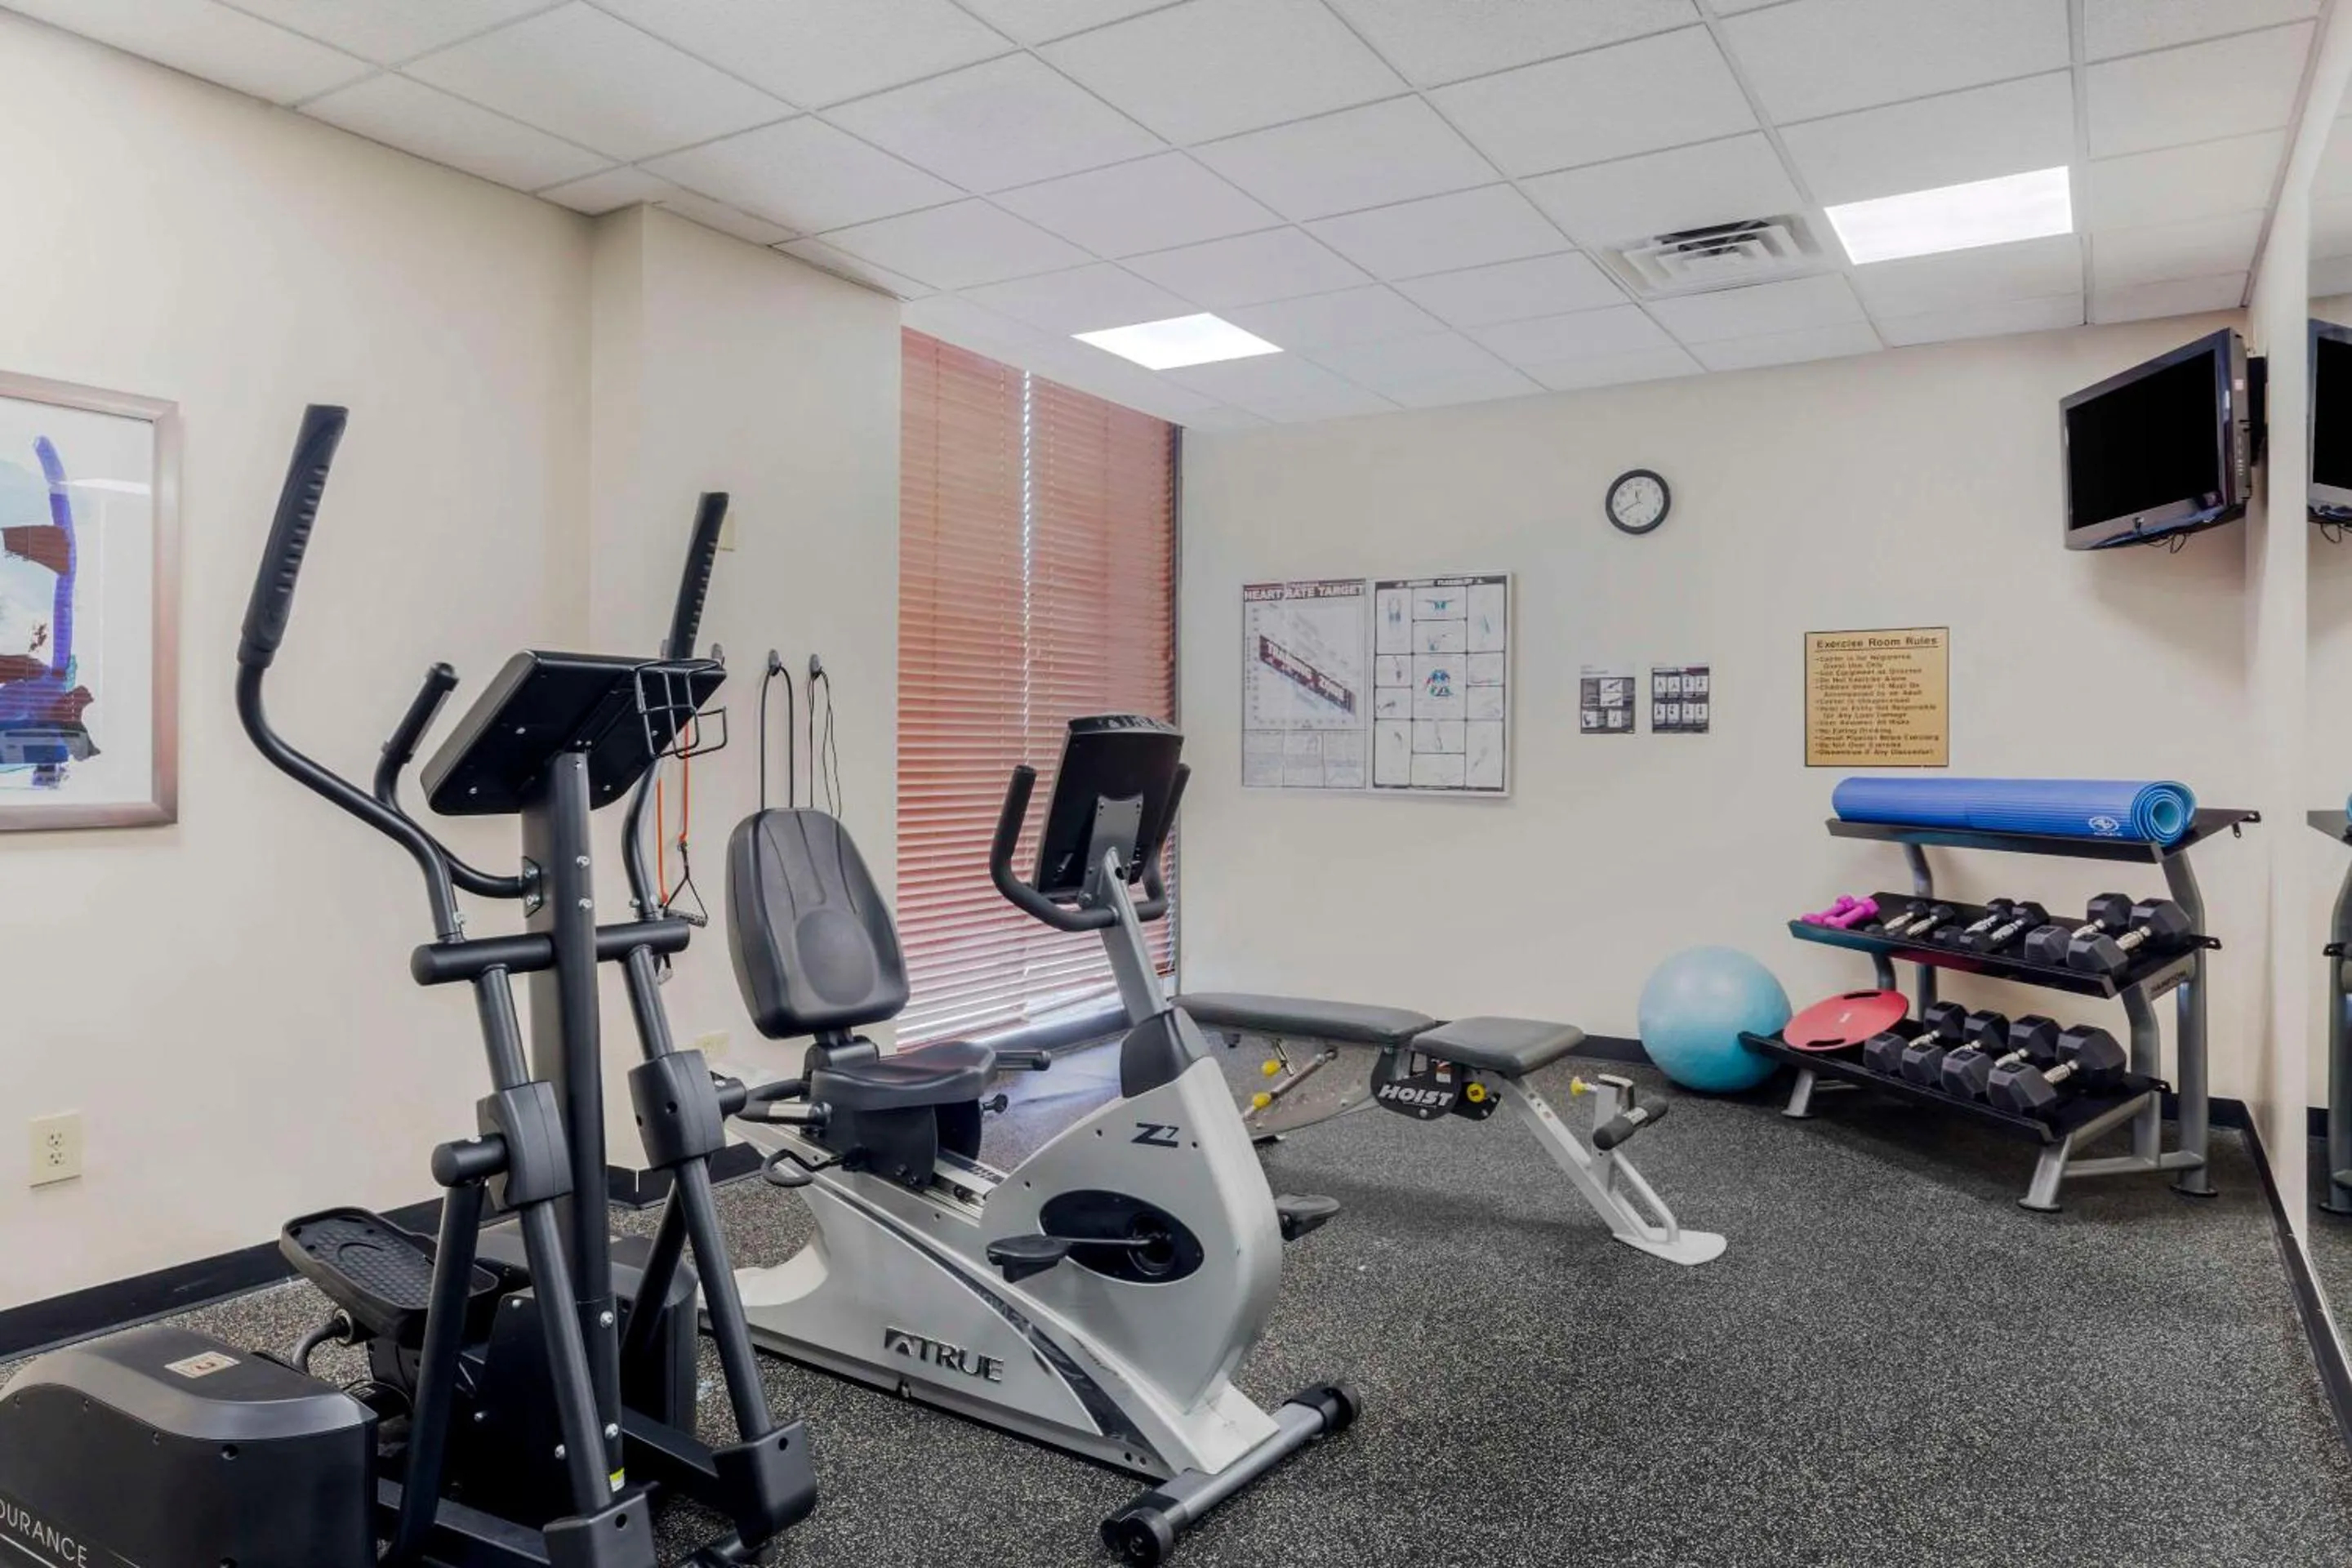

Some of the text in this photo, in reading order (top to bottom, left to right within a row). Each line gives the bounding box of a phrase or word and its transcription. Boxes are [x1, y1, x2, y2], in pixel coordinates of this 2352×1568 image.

[1244, 590, 1282, 600] HEART
[1317, 583, 1363, 597] TARGET
[1816, 636, 1939, 648] Exercise Room Rules
[1378, 1084, 1454, 1107] HOIST
[915, 1334, 1004, 1384] TRUE
